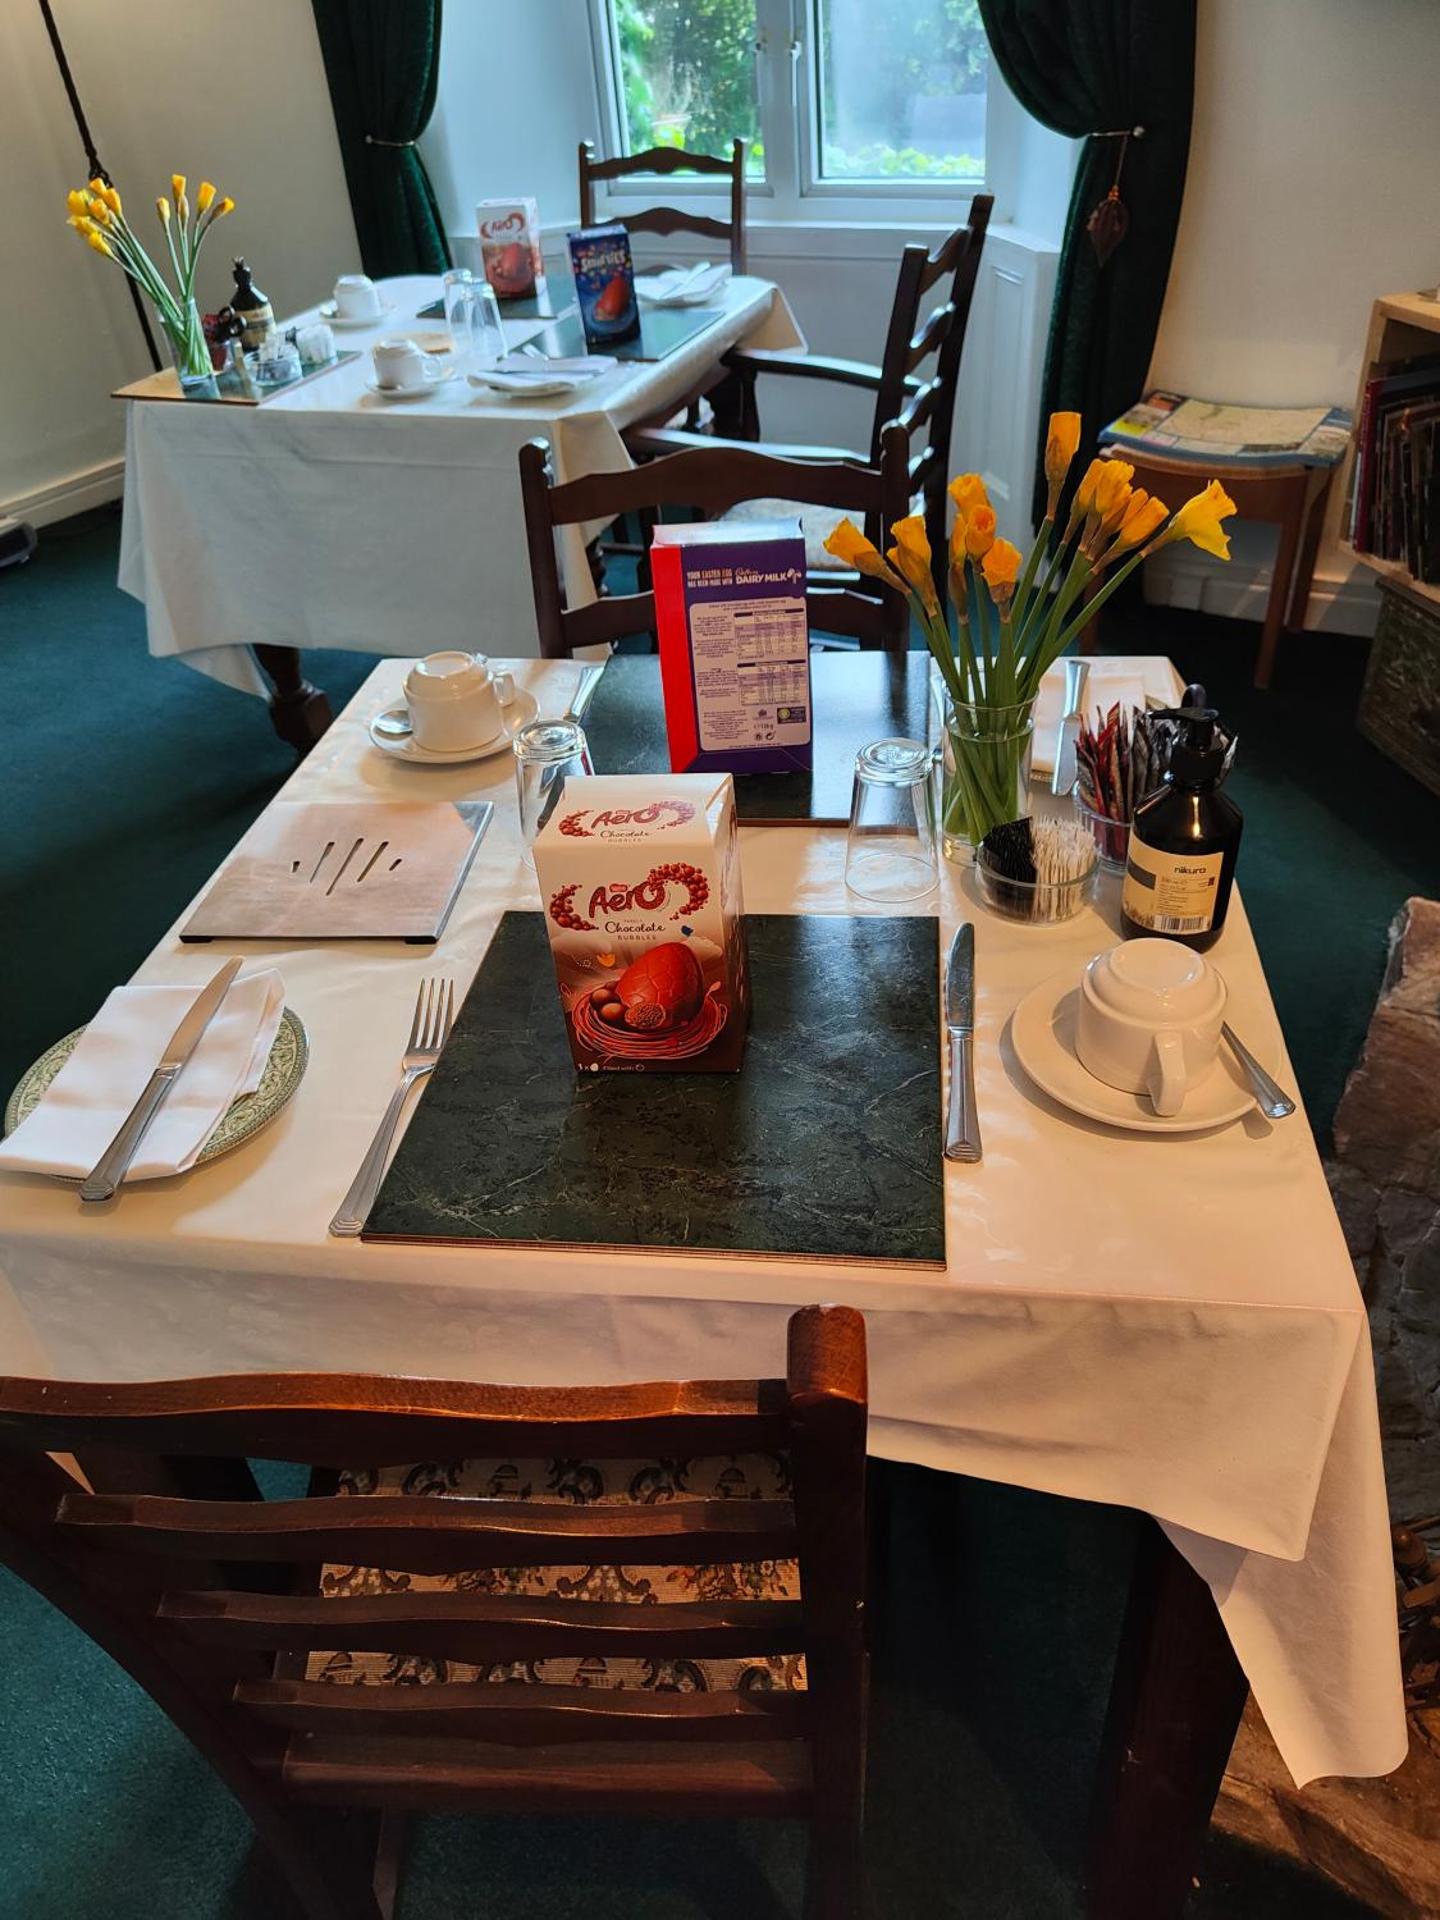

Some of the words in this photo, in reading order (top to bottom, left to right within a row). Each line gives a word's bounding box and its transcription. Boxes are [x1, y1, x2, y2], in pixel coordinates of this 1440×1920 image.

[736, 574, 764, 585] DAIRY
[764, 572, 788, 582] MILK
[600, 830, 651, 838] Chocolate
[604, 920, 667, 934] Chocolate
